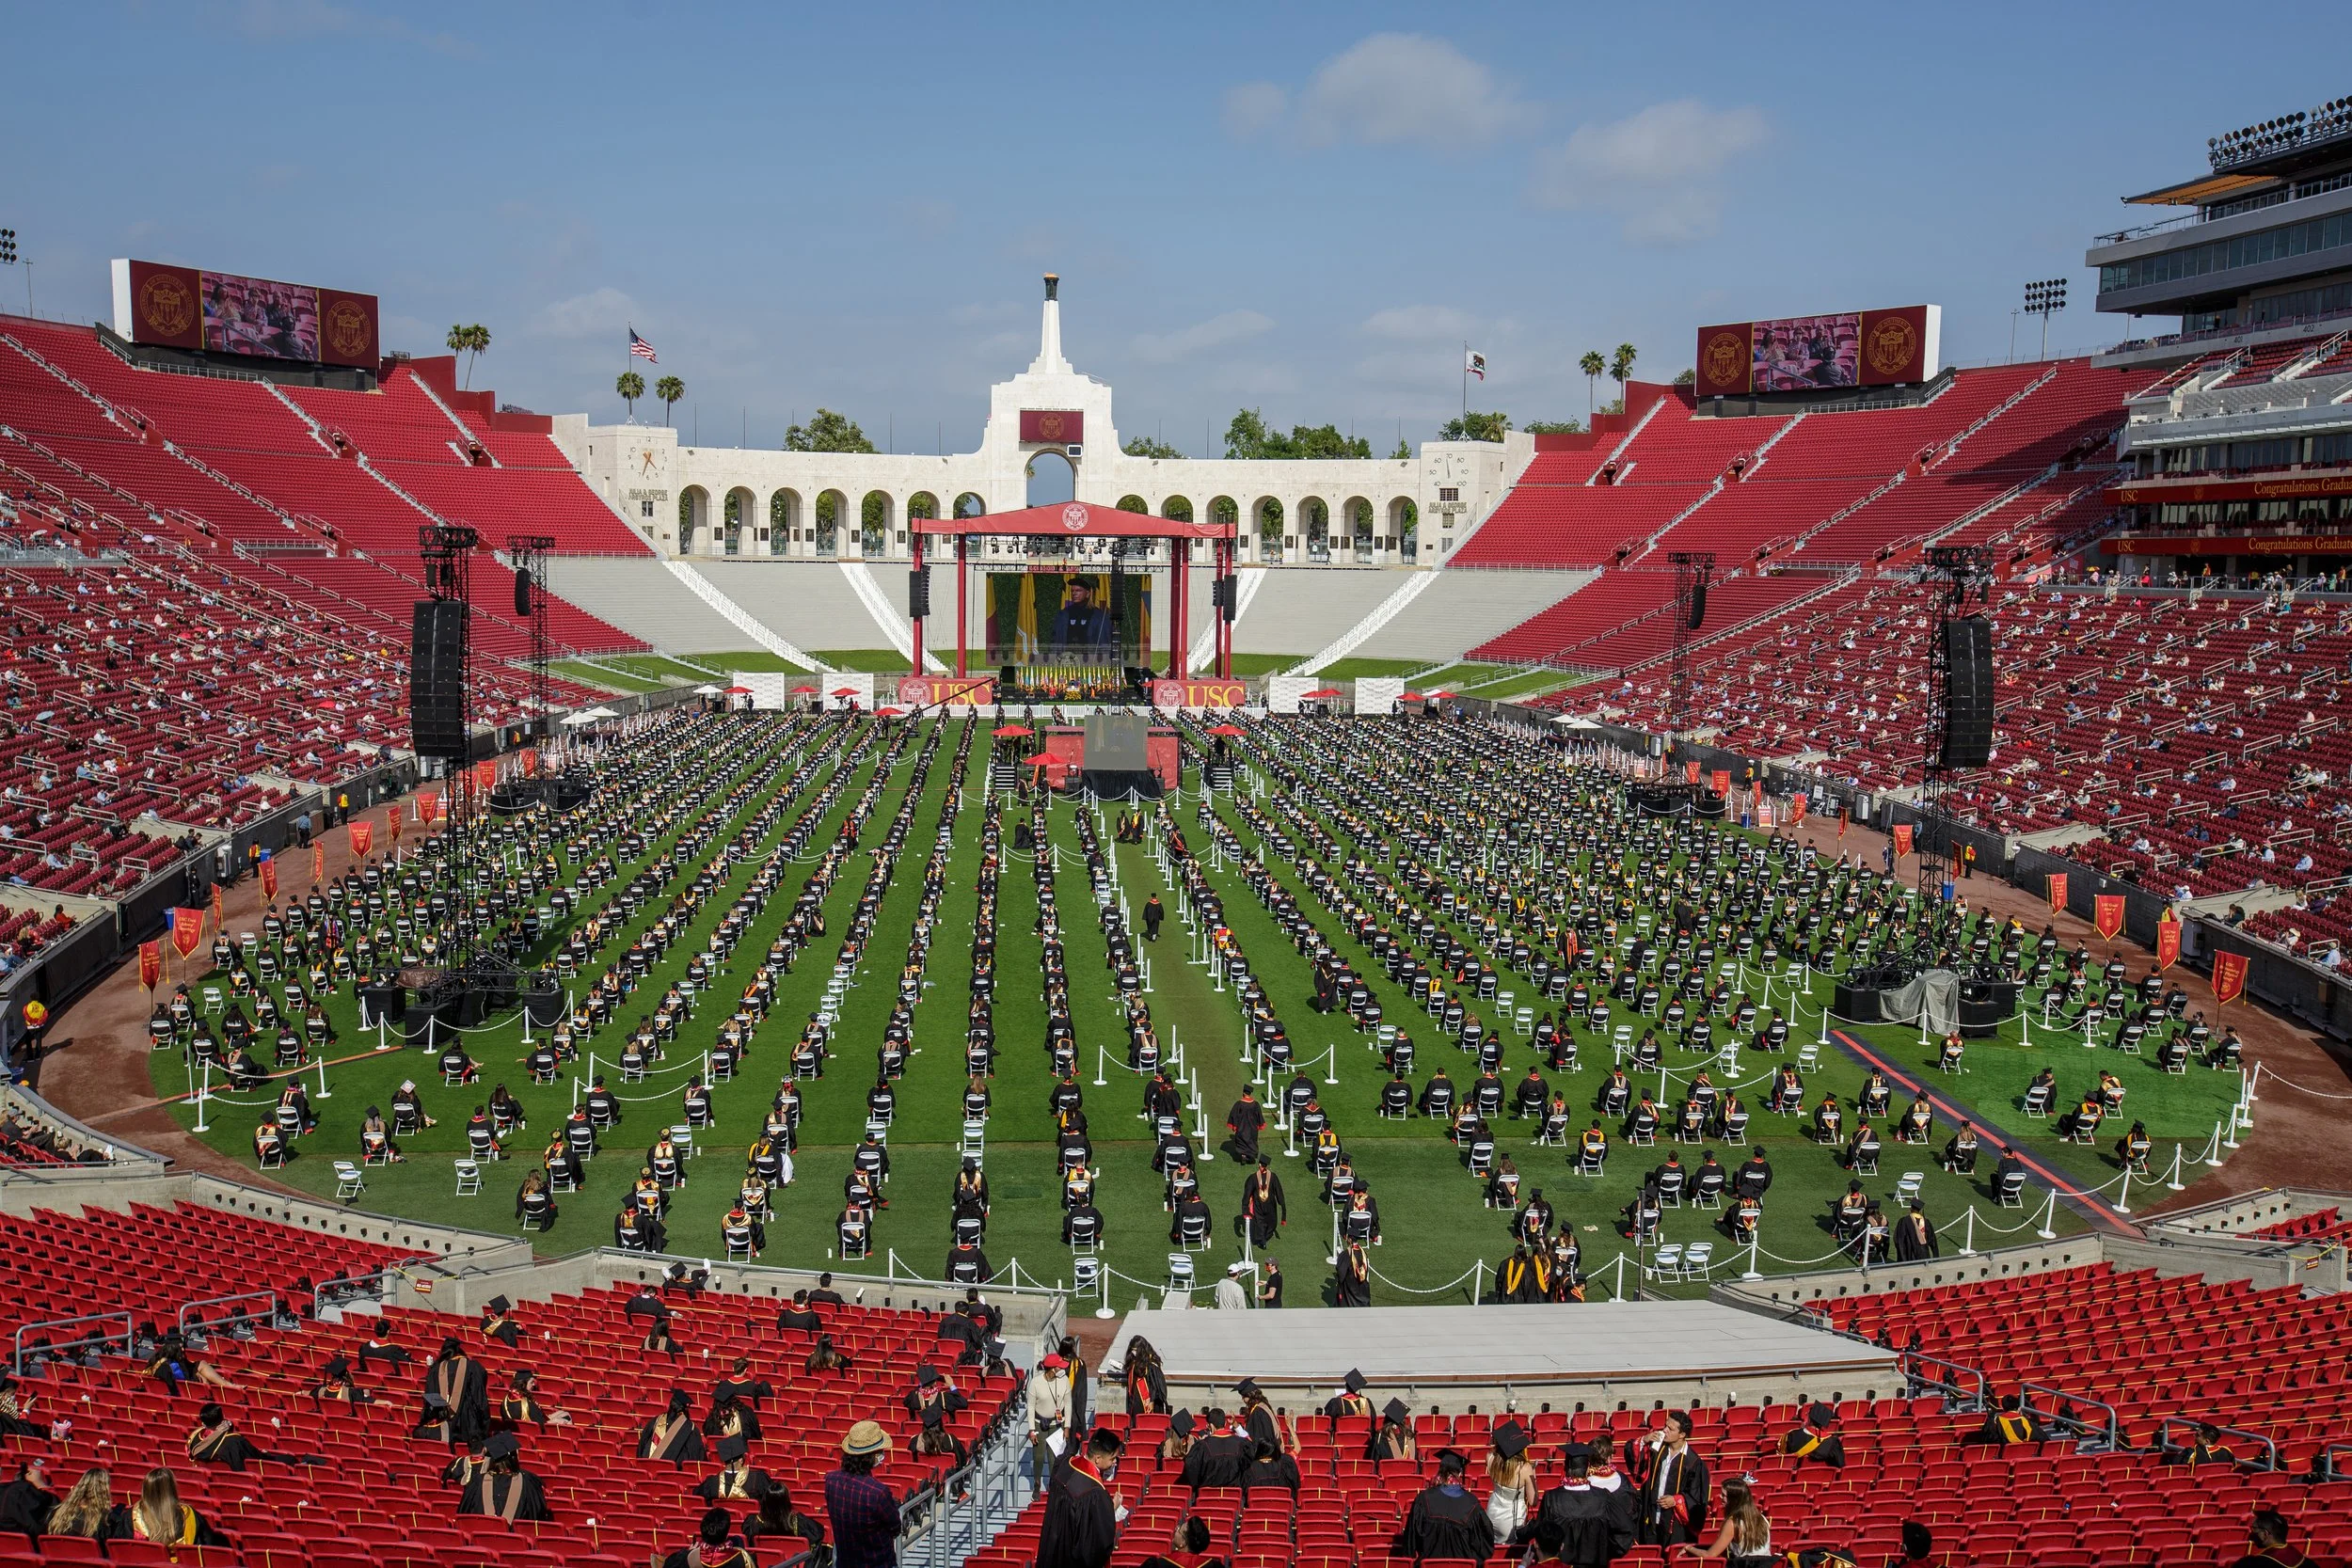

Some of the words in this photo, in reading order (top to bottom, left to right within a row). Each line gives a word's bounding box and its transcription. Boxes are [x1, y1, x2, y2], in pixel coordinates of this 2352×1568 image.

[2303, 324, 2315, 333] 402
[2121, 490, 2138, 502] USC
[2254, 480, 2320, 497] Congratulations
[2117, 540, 2135, 552] USC
[2248, 538, 2313, 554] Congratulations
[931, 683, 990, 705] USC
[1187, 685, 1244, 708] USC
